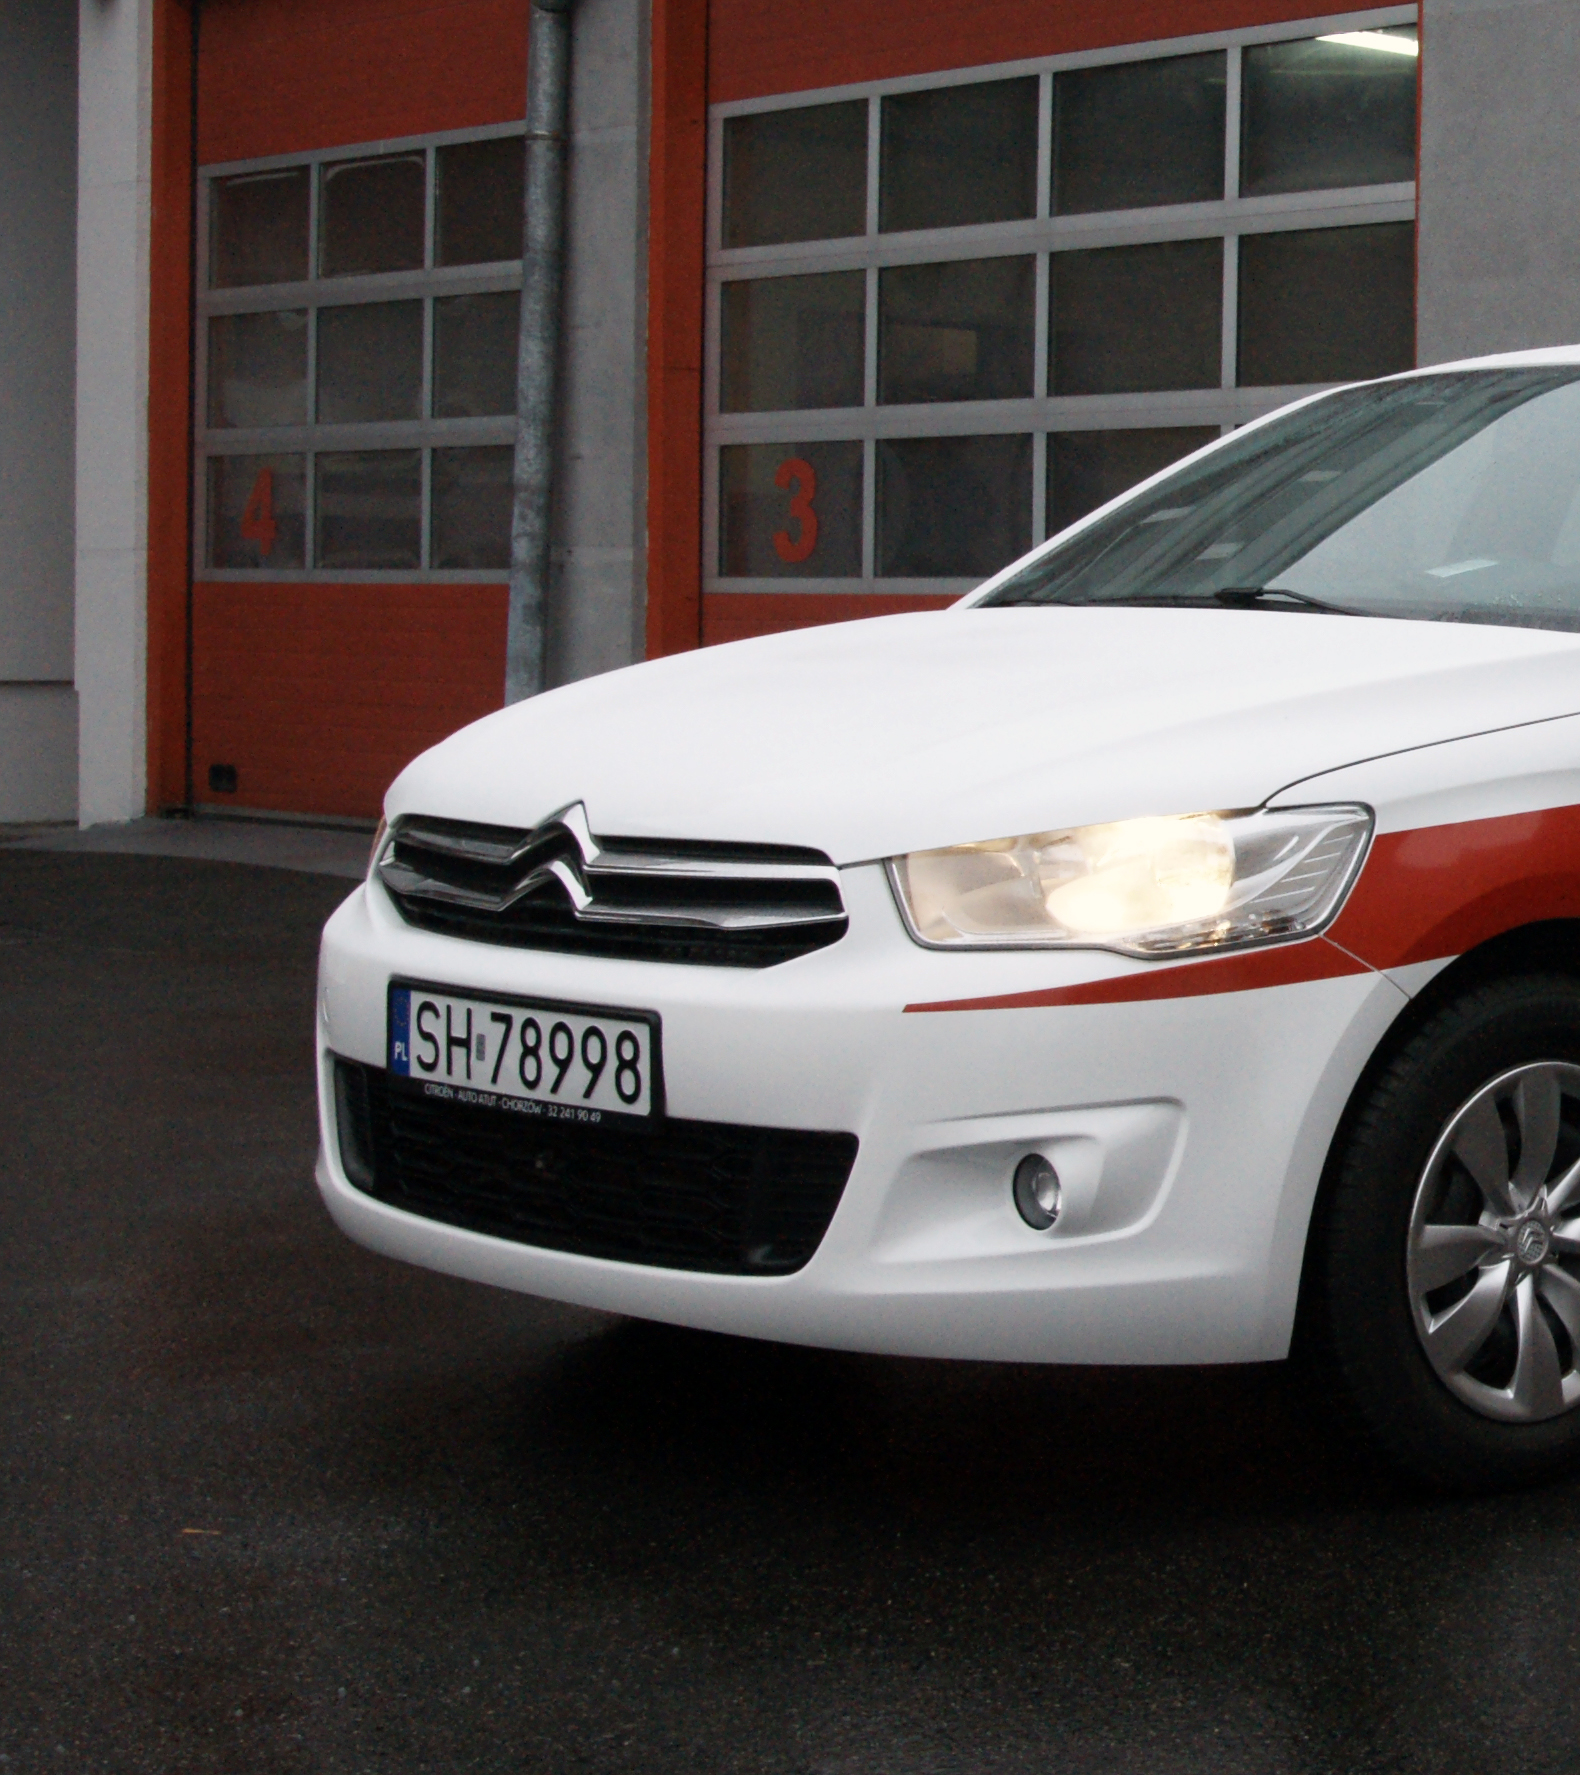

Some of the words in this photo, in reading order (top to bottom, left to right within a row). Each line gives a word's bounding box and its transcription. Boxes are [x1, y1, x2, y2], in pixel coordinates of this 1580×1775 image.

[240, 466, 277, 556] 4
[773, 457, 818, 563] 3
[394, 1041, 408, 1061] PL
[416, 1000, 472, 1080] SH
[490, 1011, 642, 1105] 78998
[458, 1091, 477, 1103] AUTO
[548, 1104, 558, 1117] 32
[560, 1107, 574, 1119] 241
[577, 1109, 588, 1121] 90
[590, 1111, 602, 1123] 49
